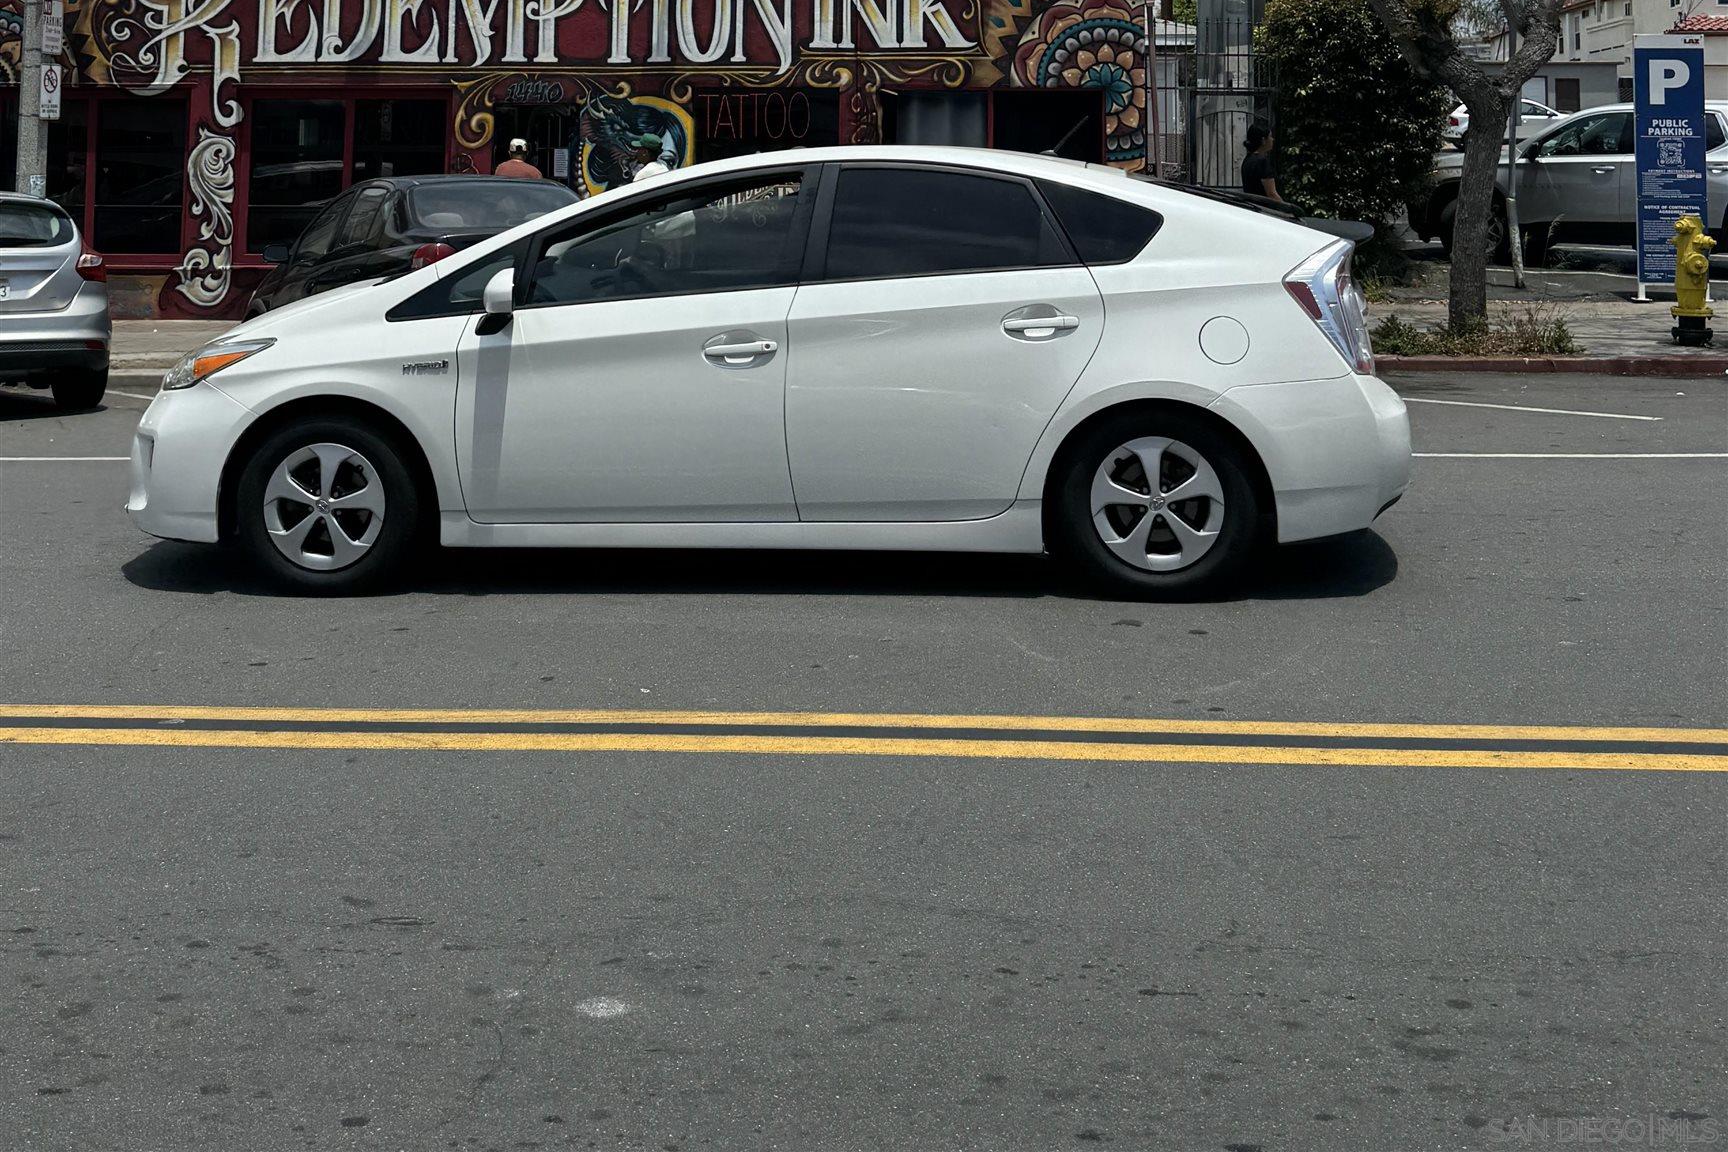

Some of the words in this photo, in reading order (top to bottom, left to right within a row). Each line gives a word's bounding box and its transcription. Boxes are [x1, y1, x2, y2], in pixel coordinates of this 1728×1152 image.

[1648, 59, 1691, 105] P
[698, 92, 811, 139] TATTOO
[1652, 119, 1689, 128] PUBLIC
[1648, 128, 1693, 136] PARKING
